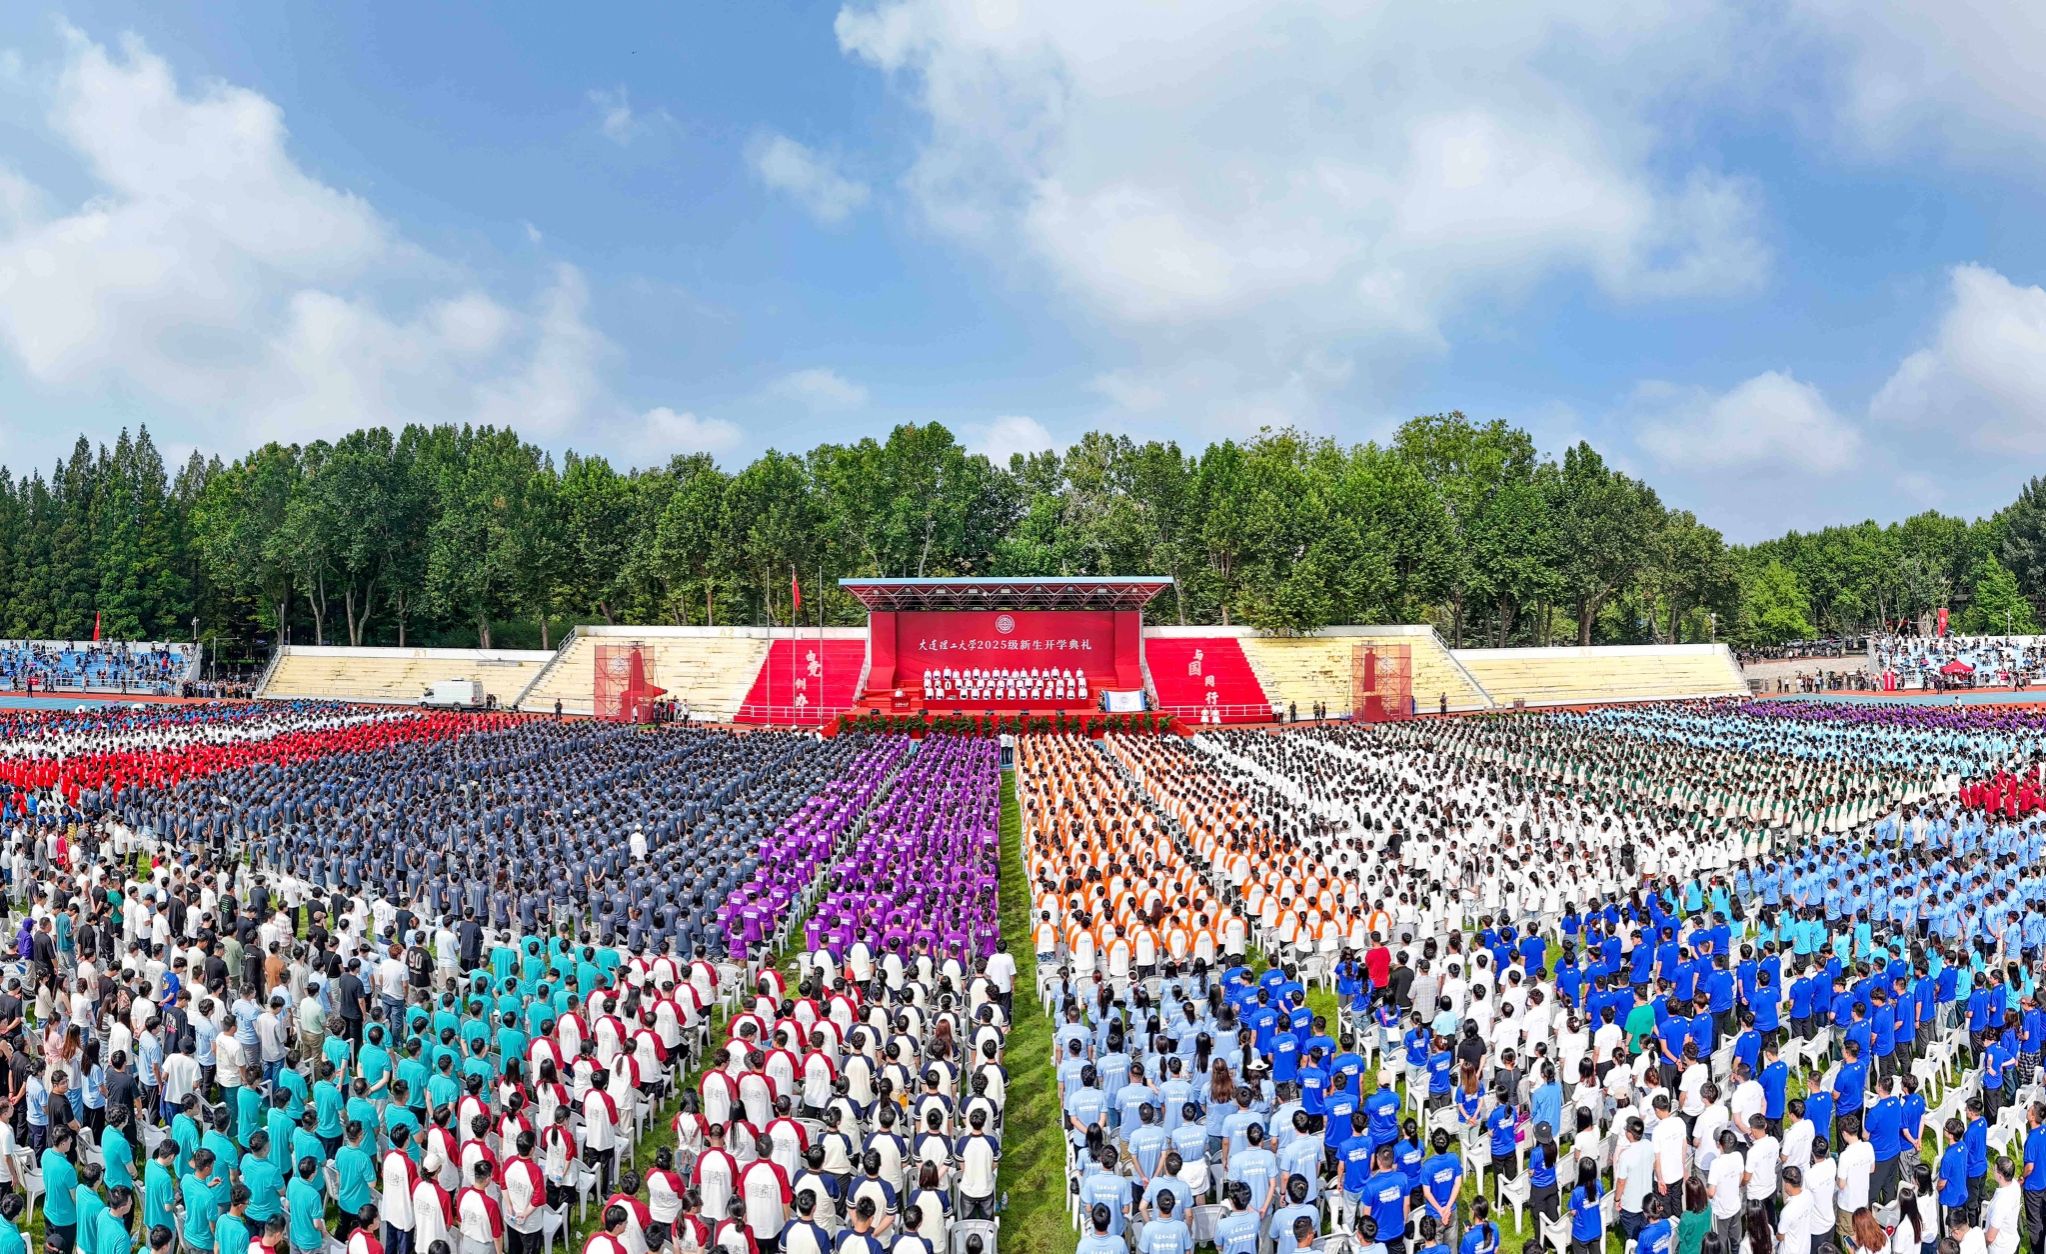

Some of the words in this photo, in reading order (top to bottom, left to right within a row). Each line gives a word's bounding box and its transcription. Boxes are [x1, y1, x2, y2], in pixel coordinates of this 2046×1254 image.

[919, 638, 1092, 651] 大连理工大学2025级新生开学典礼
[408, 950, 423, 969] 90
